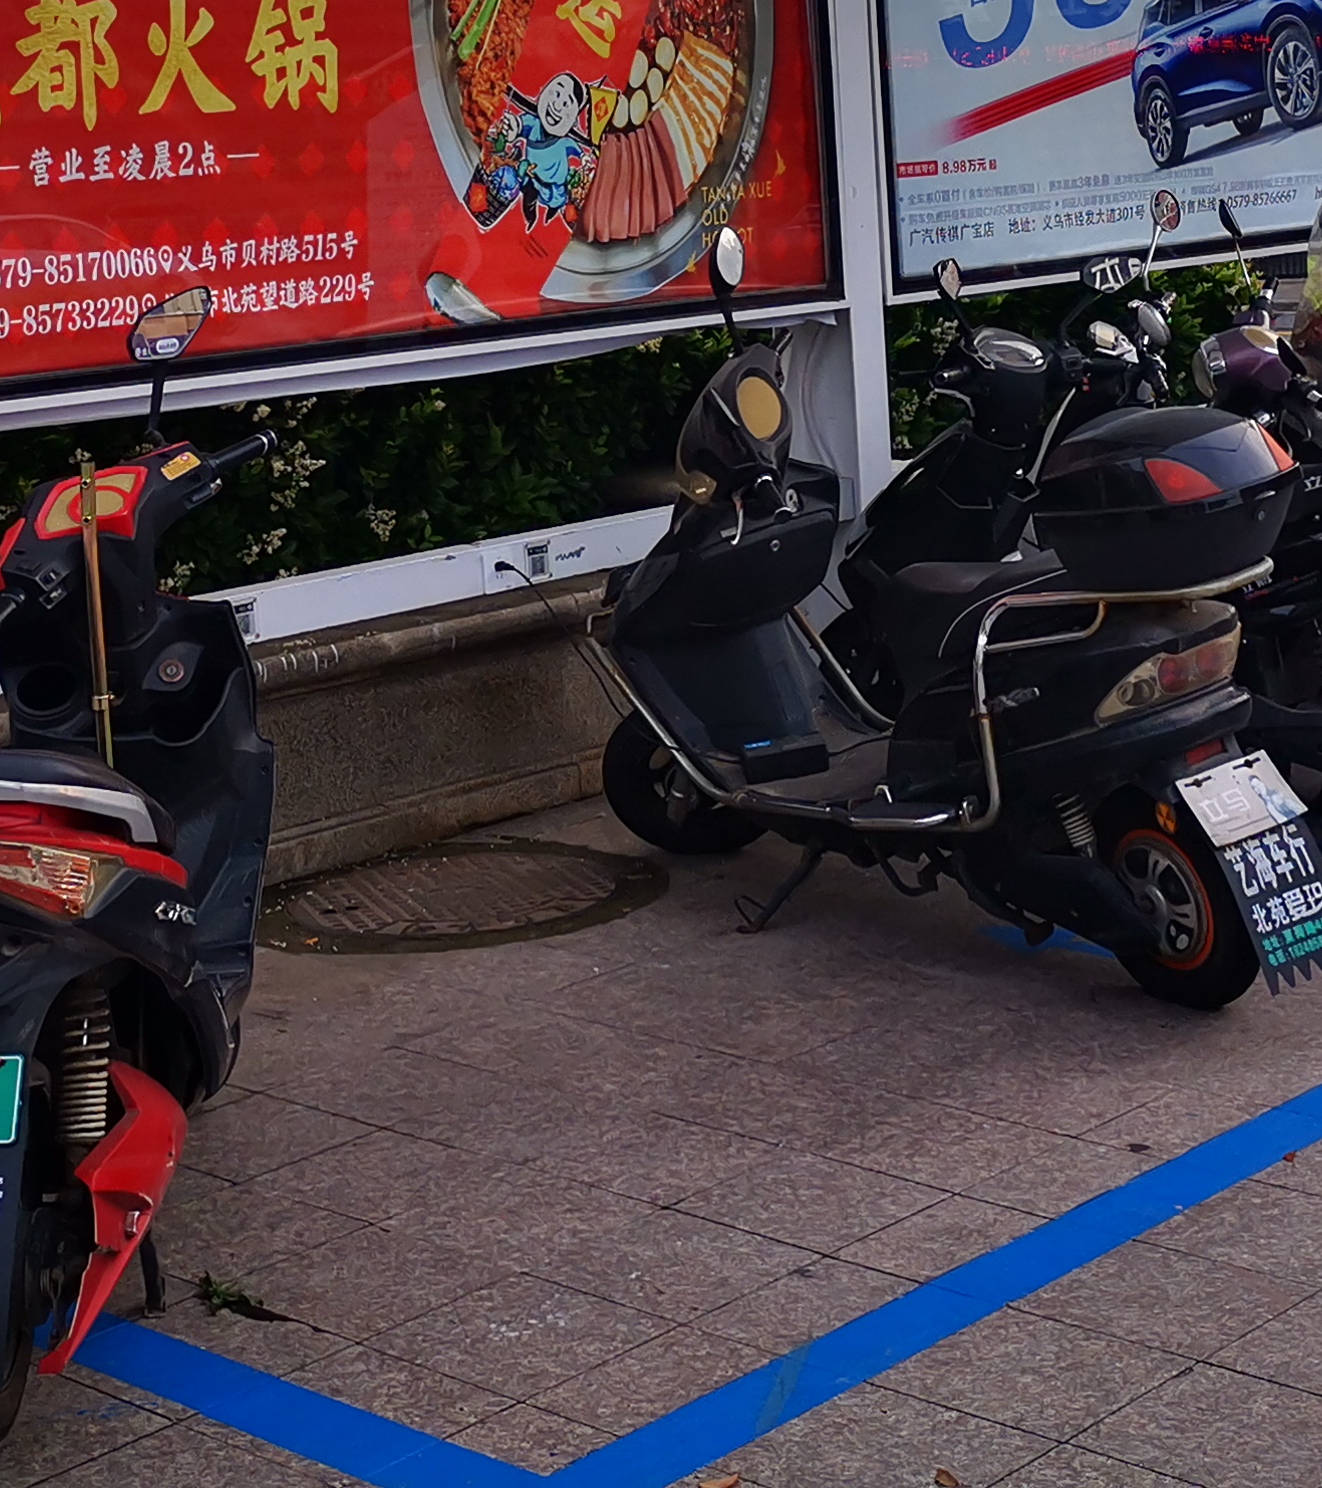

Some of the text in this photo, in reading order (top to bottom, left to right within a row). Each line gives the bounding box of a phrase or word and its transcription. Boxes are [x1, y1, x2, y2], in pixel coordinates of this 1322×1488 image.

[27, 141, 222, 187] 营业至凌晨2点
[701, 186, 726, 203] TAN
[748, 180, 772, 199] XUE
[702, 208, 729, 226] OLD
[909, 221, 995, 247] 广汽传祺广宝店
[1043, 204, 1146, 231] 义乌市经发大道301号
[177, 229, 359, 275] 义乌市贝村路515号
